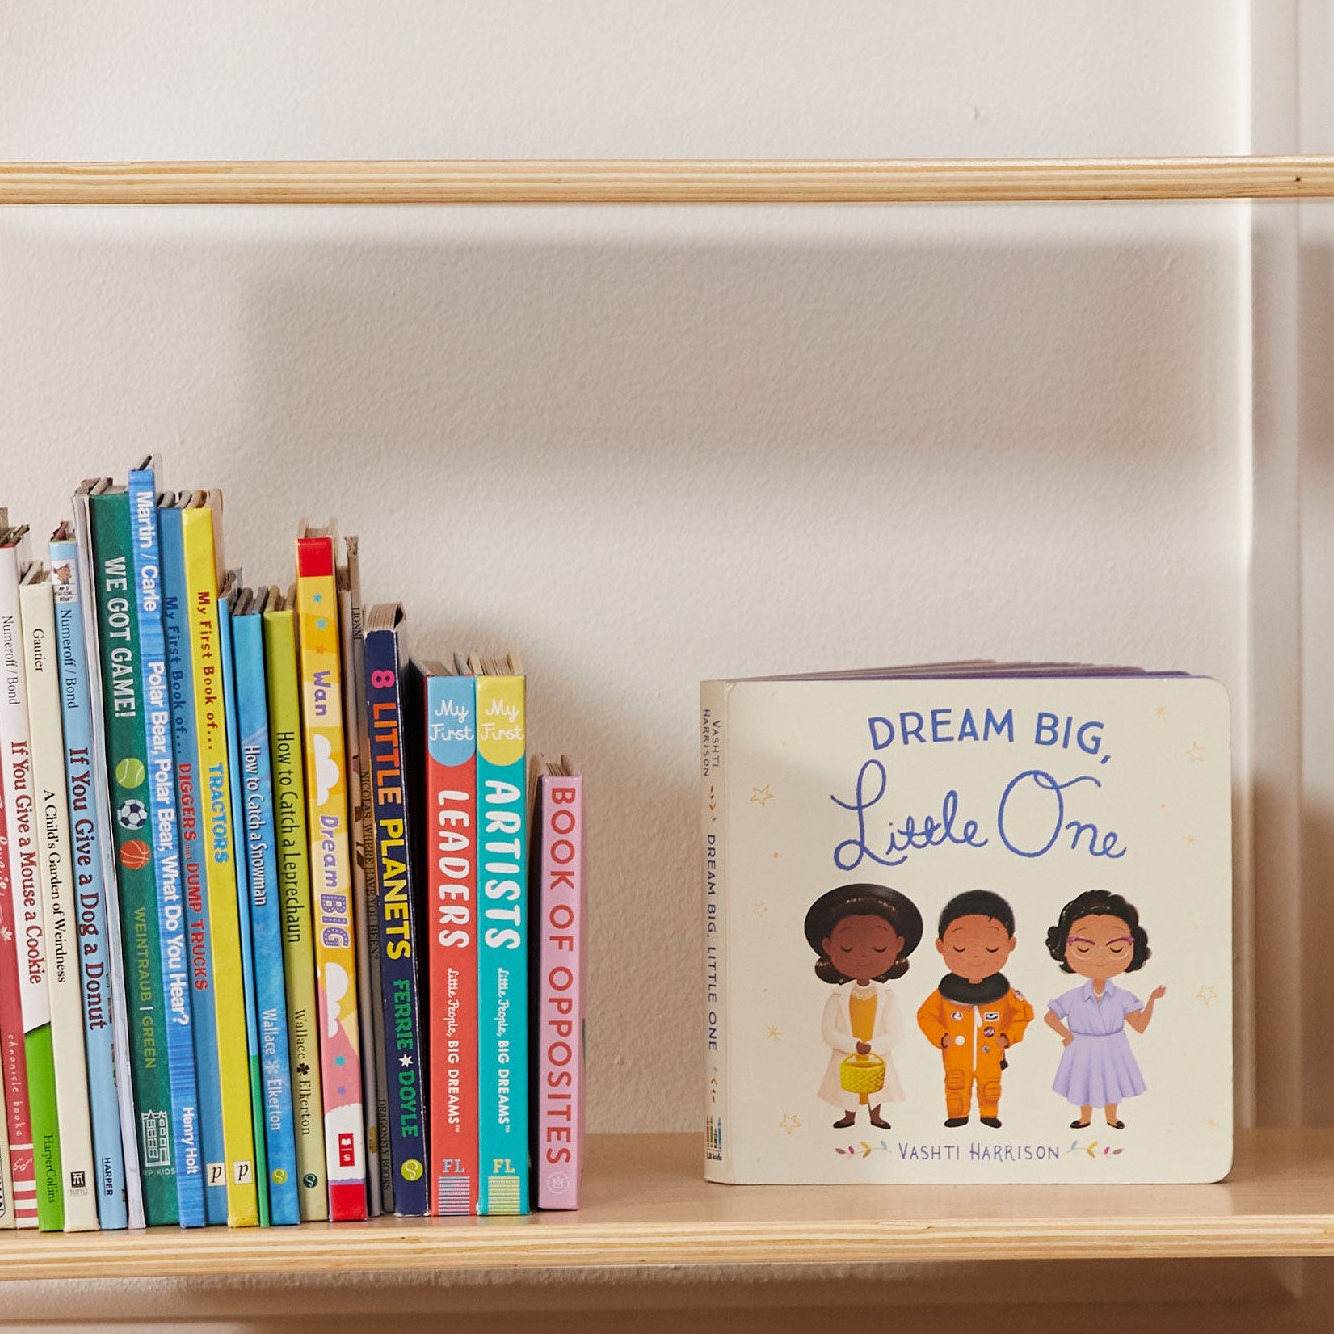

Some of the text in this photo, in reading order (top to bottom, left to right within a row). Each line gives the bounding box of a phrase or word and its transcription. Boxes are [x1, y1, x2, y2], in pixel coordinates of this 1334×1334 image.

[136, 492, 157, 548] Martin
[141, 565, 160, 612] Carle
[165, 596, 179, 617] My
[197, 592, 210, 615] My
[60, 609, 75, 666] Numeroff
[104, 556, 136, 718] WE GOT GAME!
[168, 626, 181, 664] First
[200, 621, 213, 659] First
[7, 677, 20, 705] Bond
[65, 679, 78, 709] Bond
[171, 670, 186, 710] Book
[203, 666, 217, 705] Book
[313, 670, 331, 717] Wan
[485, 698, 520, 724] My
[430, 722, 474, 742] First
[434, 699, 470, 724] My
[480, 722, 525, 742] First
[868, 708, 1111, 765] DREAM BIG,
[244, 744, 261, 778] How
[703, 708, 711, 777] HARRISON
[712, 720, 721, 767] VASHTI
[178, 763, 197, 841] DIGGERS
[245, 779, 261, 791] to
[208, 762, 230, 864] TRACTORS
[246, 793, 265, 832] Catch
[277, 731, 305, 943] How to Catch a Leprechaun
[371, 670, 411, 960] 8 LITTLE PLANETS
[830, 758, 1127, 871] Little One
[11, 740, 46, 984] If You Give a Mouse a Cookie
[148, 661, 190, 1025] Polar Bear, Polar Bear, What Do You Hear?
[484, 779, 521, 950] ARTISTS
[549, 787, 576, 891] BOOK
[707, 834, 717, 895] DREAM
[43, 789, 68, 983] A Child's Garden of Weirdness
[69, 747, 107, 1030] If You Give a Dog a Donut
[185, 863, 204, 913] DUMP
[249, 842, 267, 906] Snowman
[320, 815, 350, 948] Dream BIG
[438, 789, 470, 949] LEADERS
[133, 906, 152, 1001] WEINTRAUB
[548, 904, 575, 953] OF
[190, 918, 209, 991] TRUCKS
[707, 947, 718, 1003] LITTLE
[447, 967, 460, 998] Little
[497, 967, 510, 998] Little
[141, 1016, 157, 1069] GREEN
[443, 999, 460, 1038] People,
[493, 999, 510, 1038] People,
[708, 1011, 718, 1051] ONE
[260, 1008, 283, 1131] Wallace Elkerton
[296, 1009, 312, 1135] Wallace Elkerton
[392, 979, 419, 1139] FERRIE DOYLE
[447, 1040, 460, 1064] BIG
[497, 1040, 510, 1064] BIG
[546, 966, 574, 1165] OPPOSITES
[8, 1034, 23, 1137] chronicle books
[181, 1107, 199, 1175] Henry Holt
[442, 1158, 465, 1173] FL
[492, 1158, 516, 1173] FL
[898, 1142, 1060, 1163] VASHTI HARRISON
[41, 1134, 57, 1204] HarperCollins
[105, 1157, 113, 1196] HARPER
